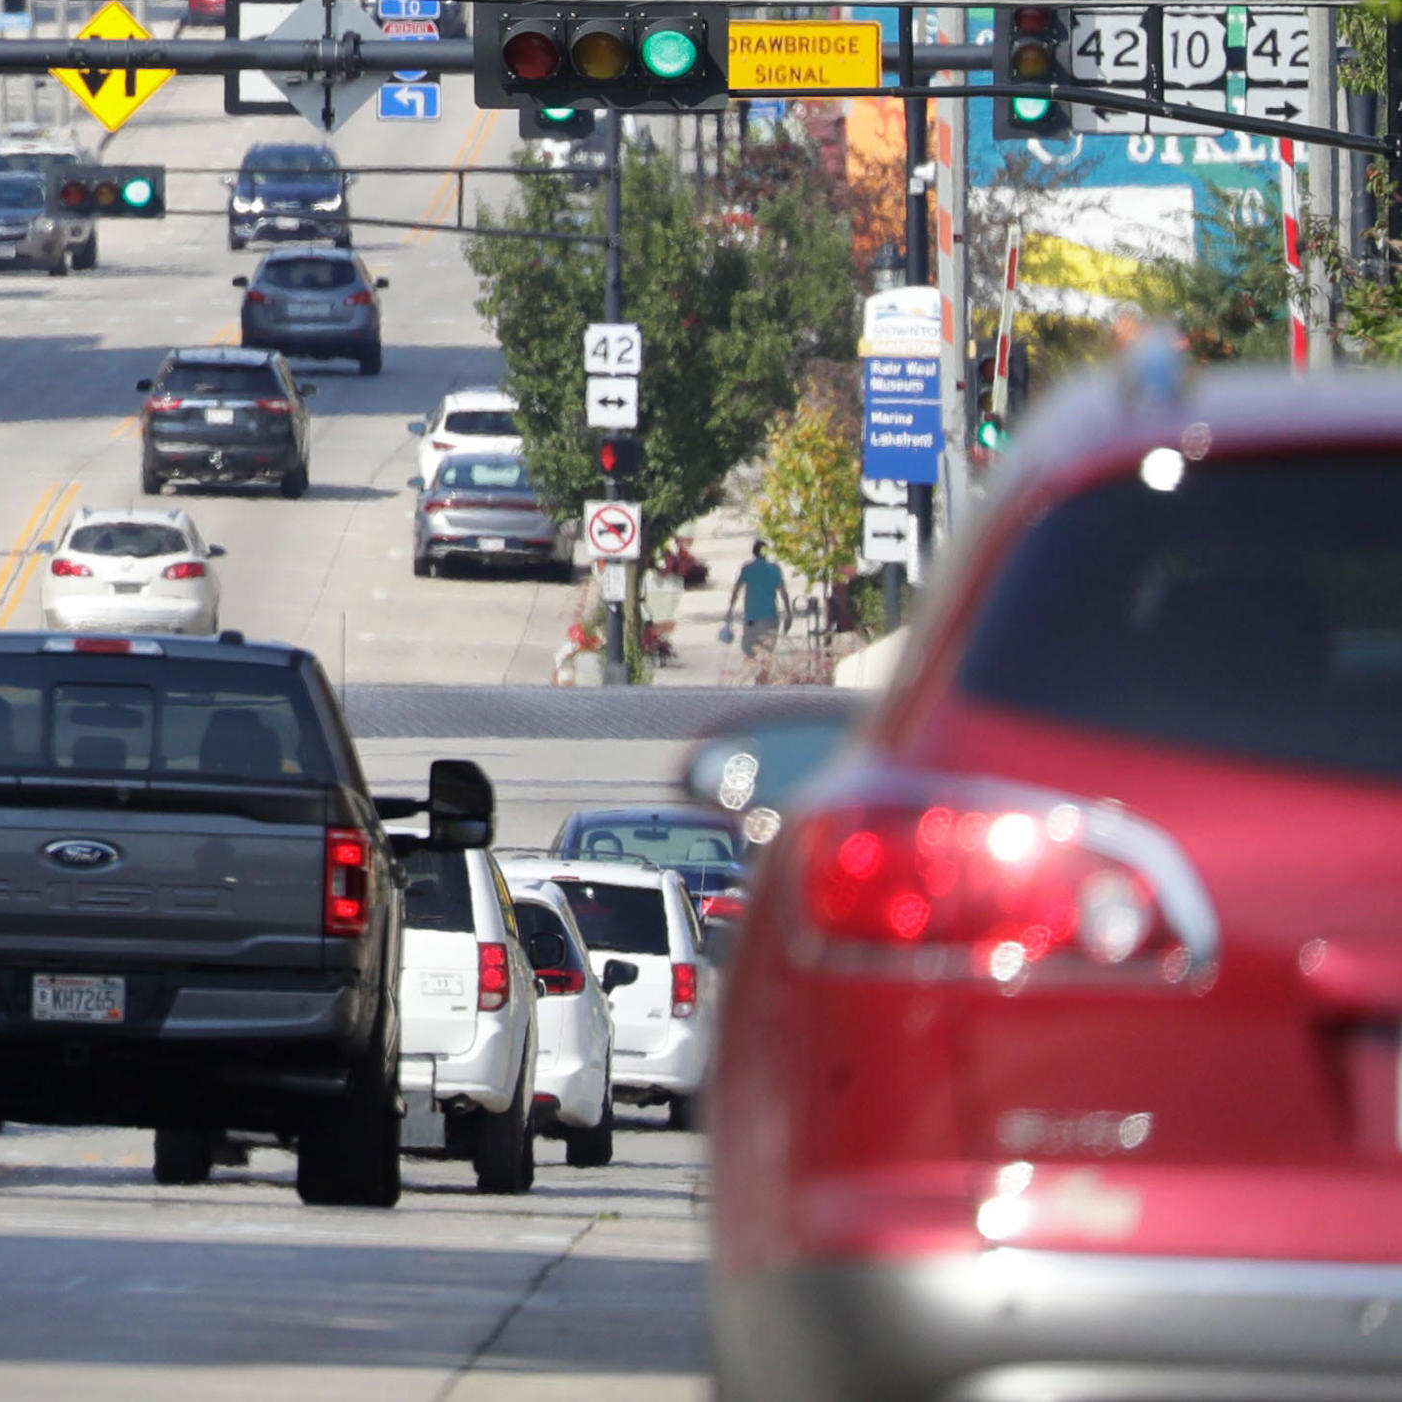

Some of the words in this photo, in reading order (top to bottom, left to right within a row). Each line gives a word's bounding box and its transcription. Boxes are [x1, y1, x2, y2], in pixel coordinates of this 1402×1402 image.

[399, 0, 420, 16] TO
[729, 35, 860, 56] DRAWBRIDGE
[1077, 28, 1140, 68] 42
[1170, 29, 1210, 69] 10
[1252, 28, 1309, 68] 42
[755, 67, 830, 85] SIGNAL
[591, 336, 634, 365] 42
